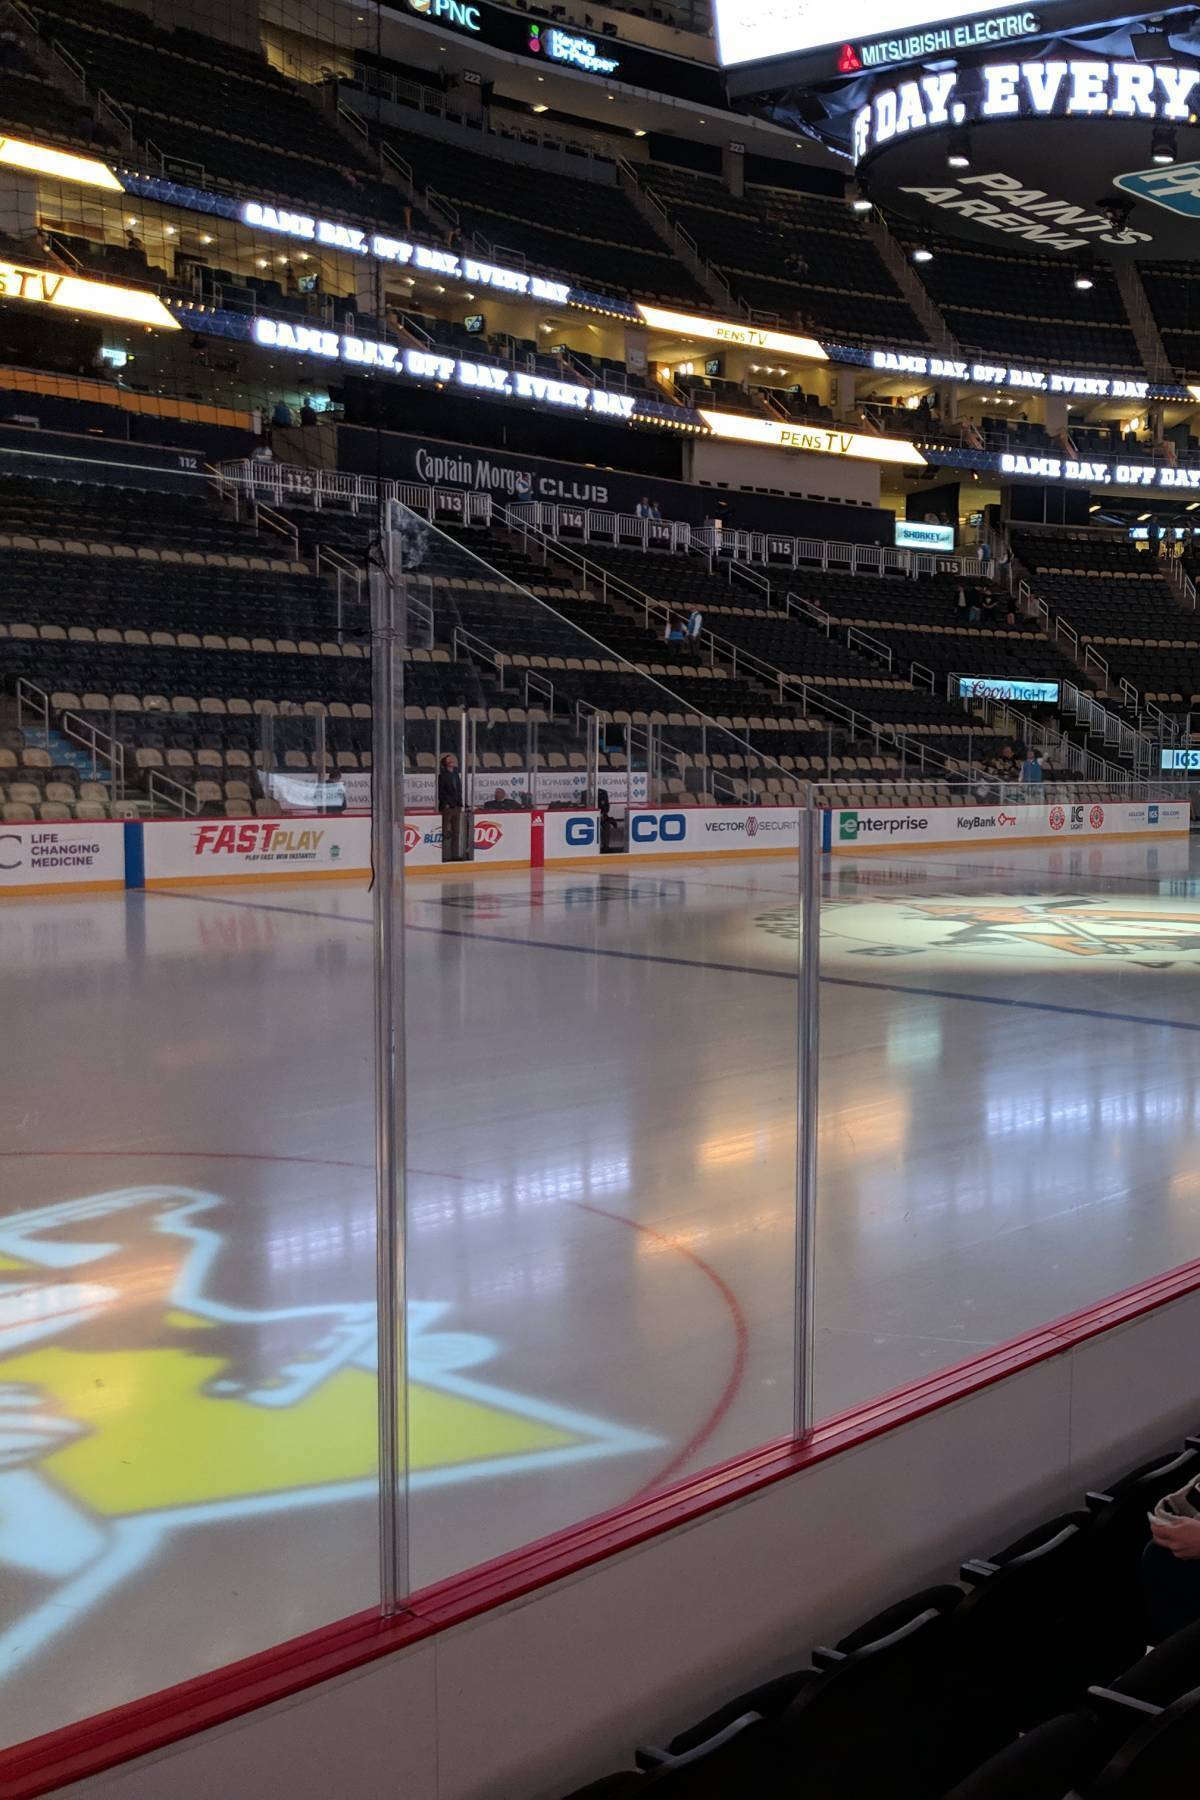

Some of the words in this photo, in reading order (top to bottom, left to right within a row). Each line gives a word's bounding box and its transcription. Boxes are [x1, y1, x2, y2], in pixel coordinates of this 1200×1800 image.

[434, 0, 480, 30] PNC
[552, 29, 595, 56] Keurig
[862, 30, 951, 66] MITSUBISHI
[954, 12, 1038, 47] ELECTRIC
[876, 72, 966, 142] DAY,
[984, 61, 1200, 120] EVERY
[956, 173, 1152, 245] PAINTS
[898, 187, 1091, 250] ARENA
[179, 457, 197, 468] 112
[415, 448, 472, 485] Captain
[539, 478, 608, 503] CLUB
[1116, 465, 1155, 484] OFF
[440, 495, 462, 511] 113
[563, 513, 582, 527] 114
[651, 526, 670, 539] 114
[772, 541, 790, 554] 115
[940, 560, 958, 574] 115
[973, 681, 1012, 699] Coors
[1013, 686, 1047, 700] LIGHT
[705, 822, 745, 832] VECTOR
[840, 816, 928, 834] enterprise
[957, 816, 996, 829] KeyBank
[31, 834, 59, 844] LIFE
[195, 824, 280, 854] FAST
[271, 831, 325, 851] PLAY
[31, 844, 100, 856] CHANGING
[31, 856, 93, 868] MEDICINE
